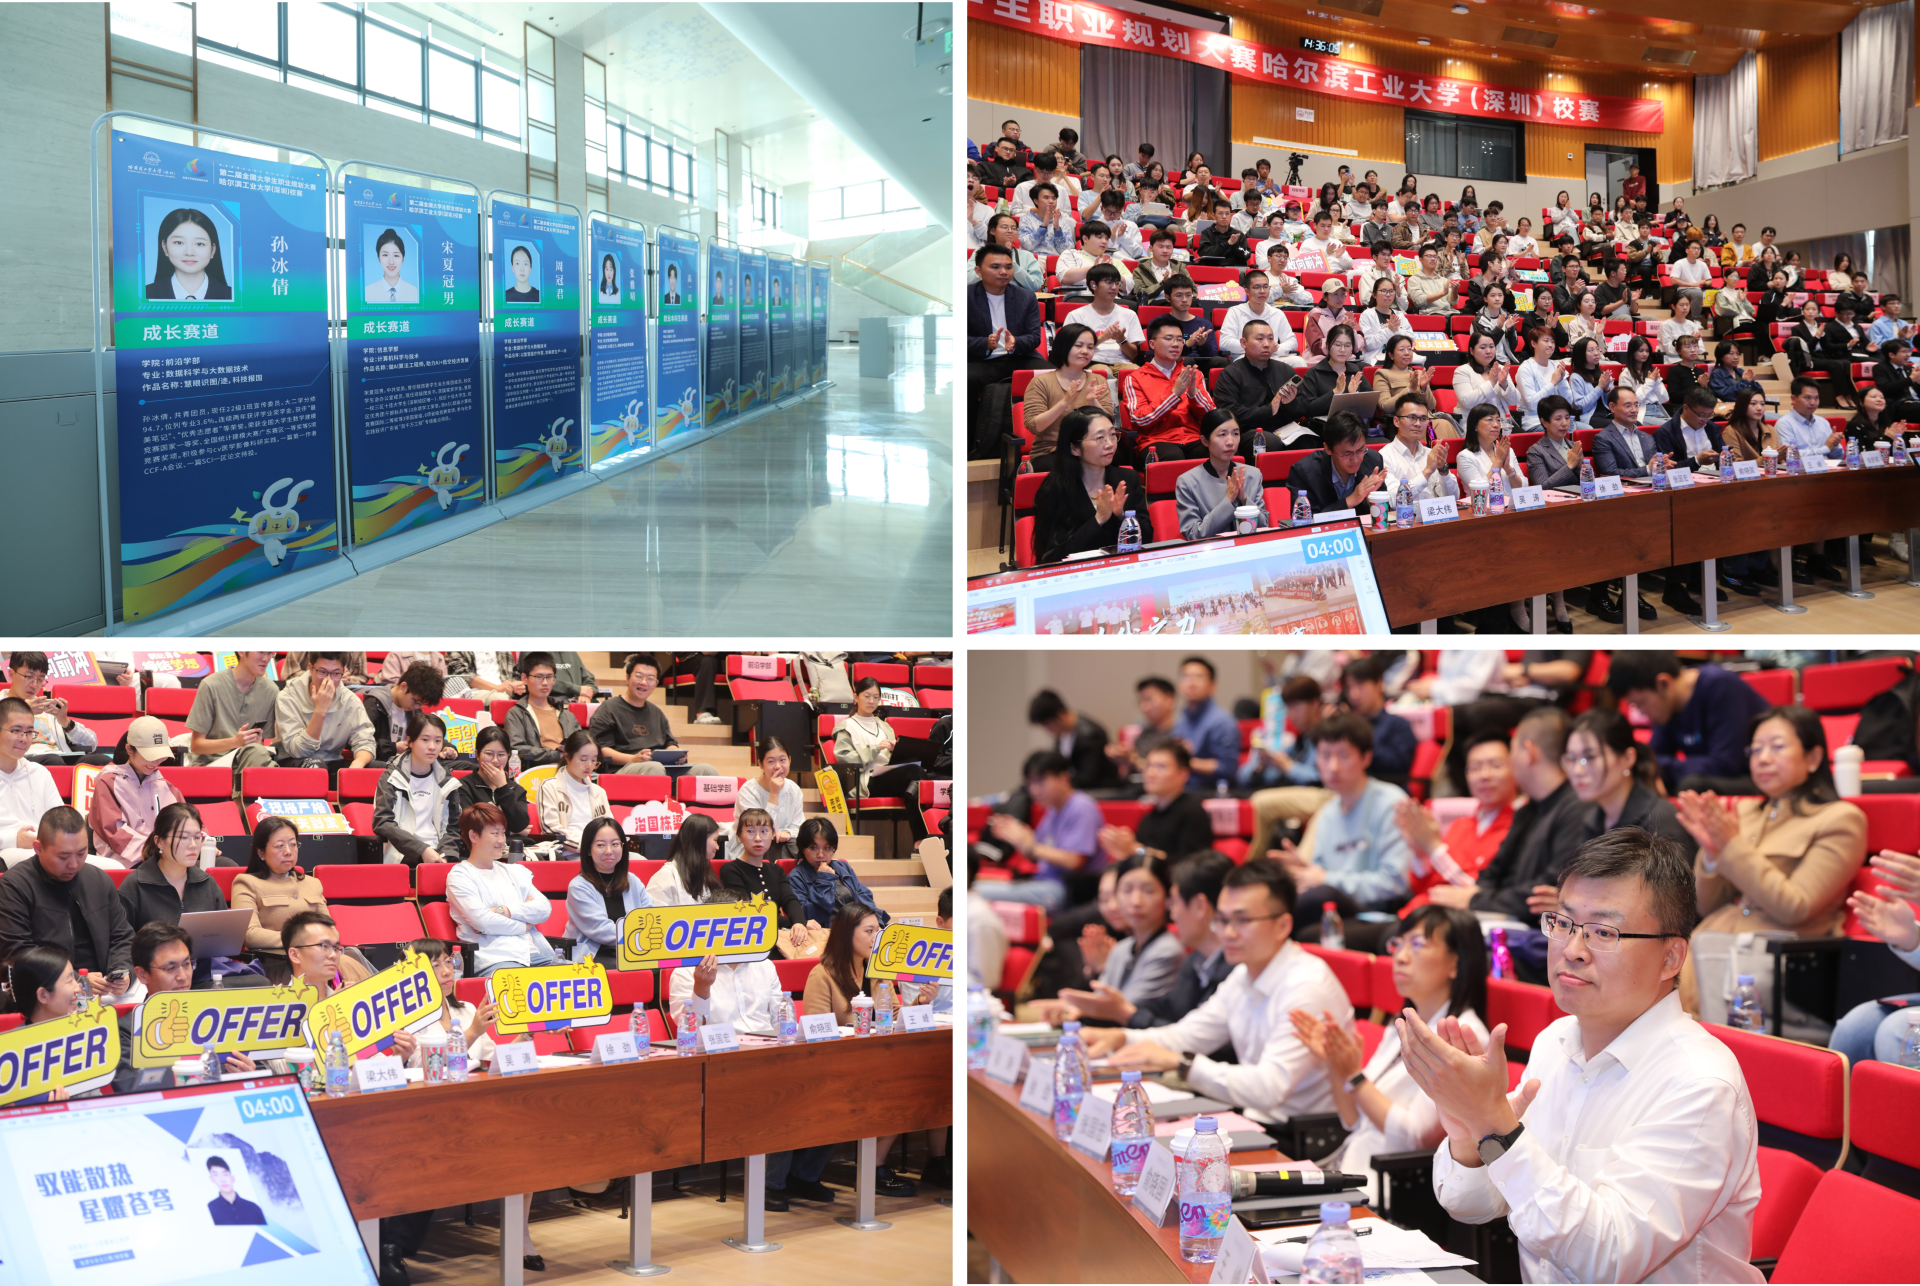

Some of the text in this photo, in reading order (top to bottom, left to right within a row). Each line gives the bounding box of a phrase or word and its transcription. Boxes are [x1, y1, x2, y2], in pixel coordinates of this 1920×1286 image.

[968, 0, 1600, 123] 生职业规划大赛哈尔滨工业大学（深圳）校赛
[219, 168, 317, 191] 第二届全国大学生职业规划大赛
[270, 236, 289, 297] 孙冰倩
[441, 240, 455, 306] 宋夏冠男
[1287, 254, 1324, 270] 敢向前冲
[142, 324, 219, 342] 成长赛道
[363, 320, 410, 334] 成长赛道
[504, 317, 535, 328] 成长赛道
[1427, 503, 1453, 517] 梁大伟
[1306, 537, 1355, 560] 04:00
[747, 661, 772, 670] 前沿学部
[446, 723, 478, 743] 再创
[703, 783, 732, 793] 基础学部
[267, 799, 328, 815] 规格严格
[289, 816, 340, 831] 夫到家
[665, 915, 769, 952] OFFER
[905, 939, 953, 972] OFF
[351, 969, 433, 1039] OFFER
[526, 977, 603, 1014] OFFER
[190, 1002, 308, 1046] OFFER
[0, 1026, 109, 1095] OFFER
[365, 1067, 399, 1083] 梁大伟
[241, 1095, 296, 1119] 04:00
[34, 1162, 134, 1198] 驭能散热
[78, 1188, 175, 1225] 星耀苍穹
